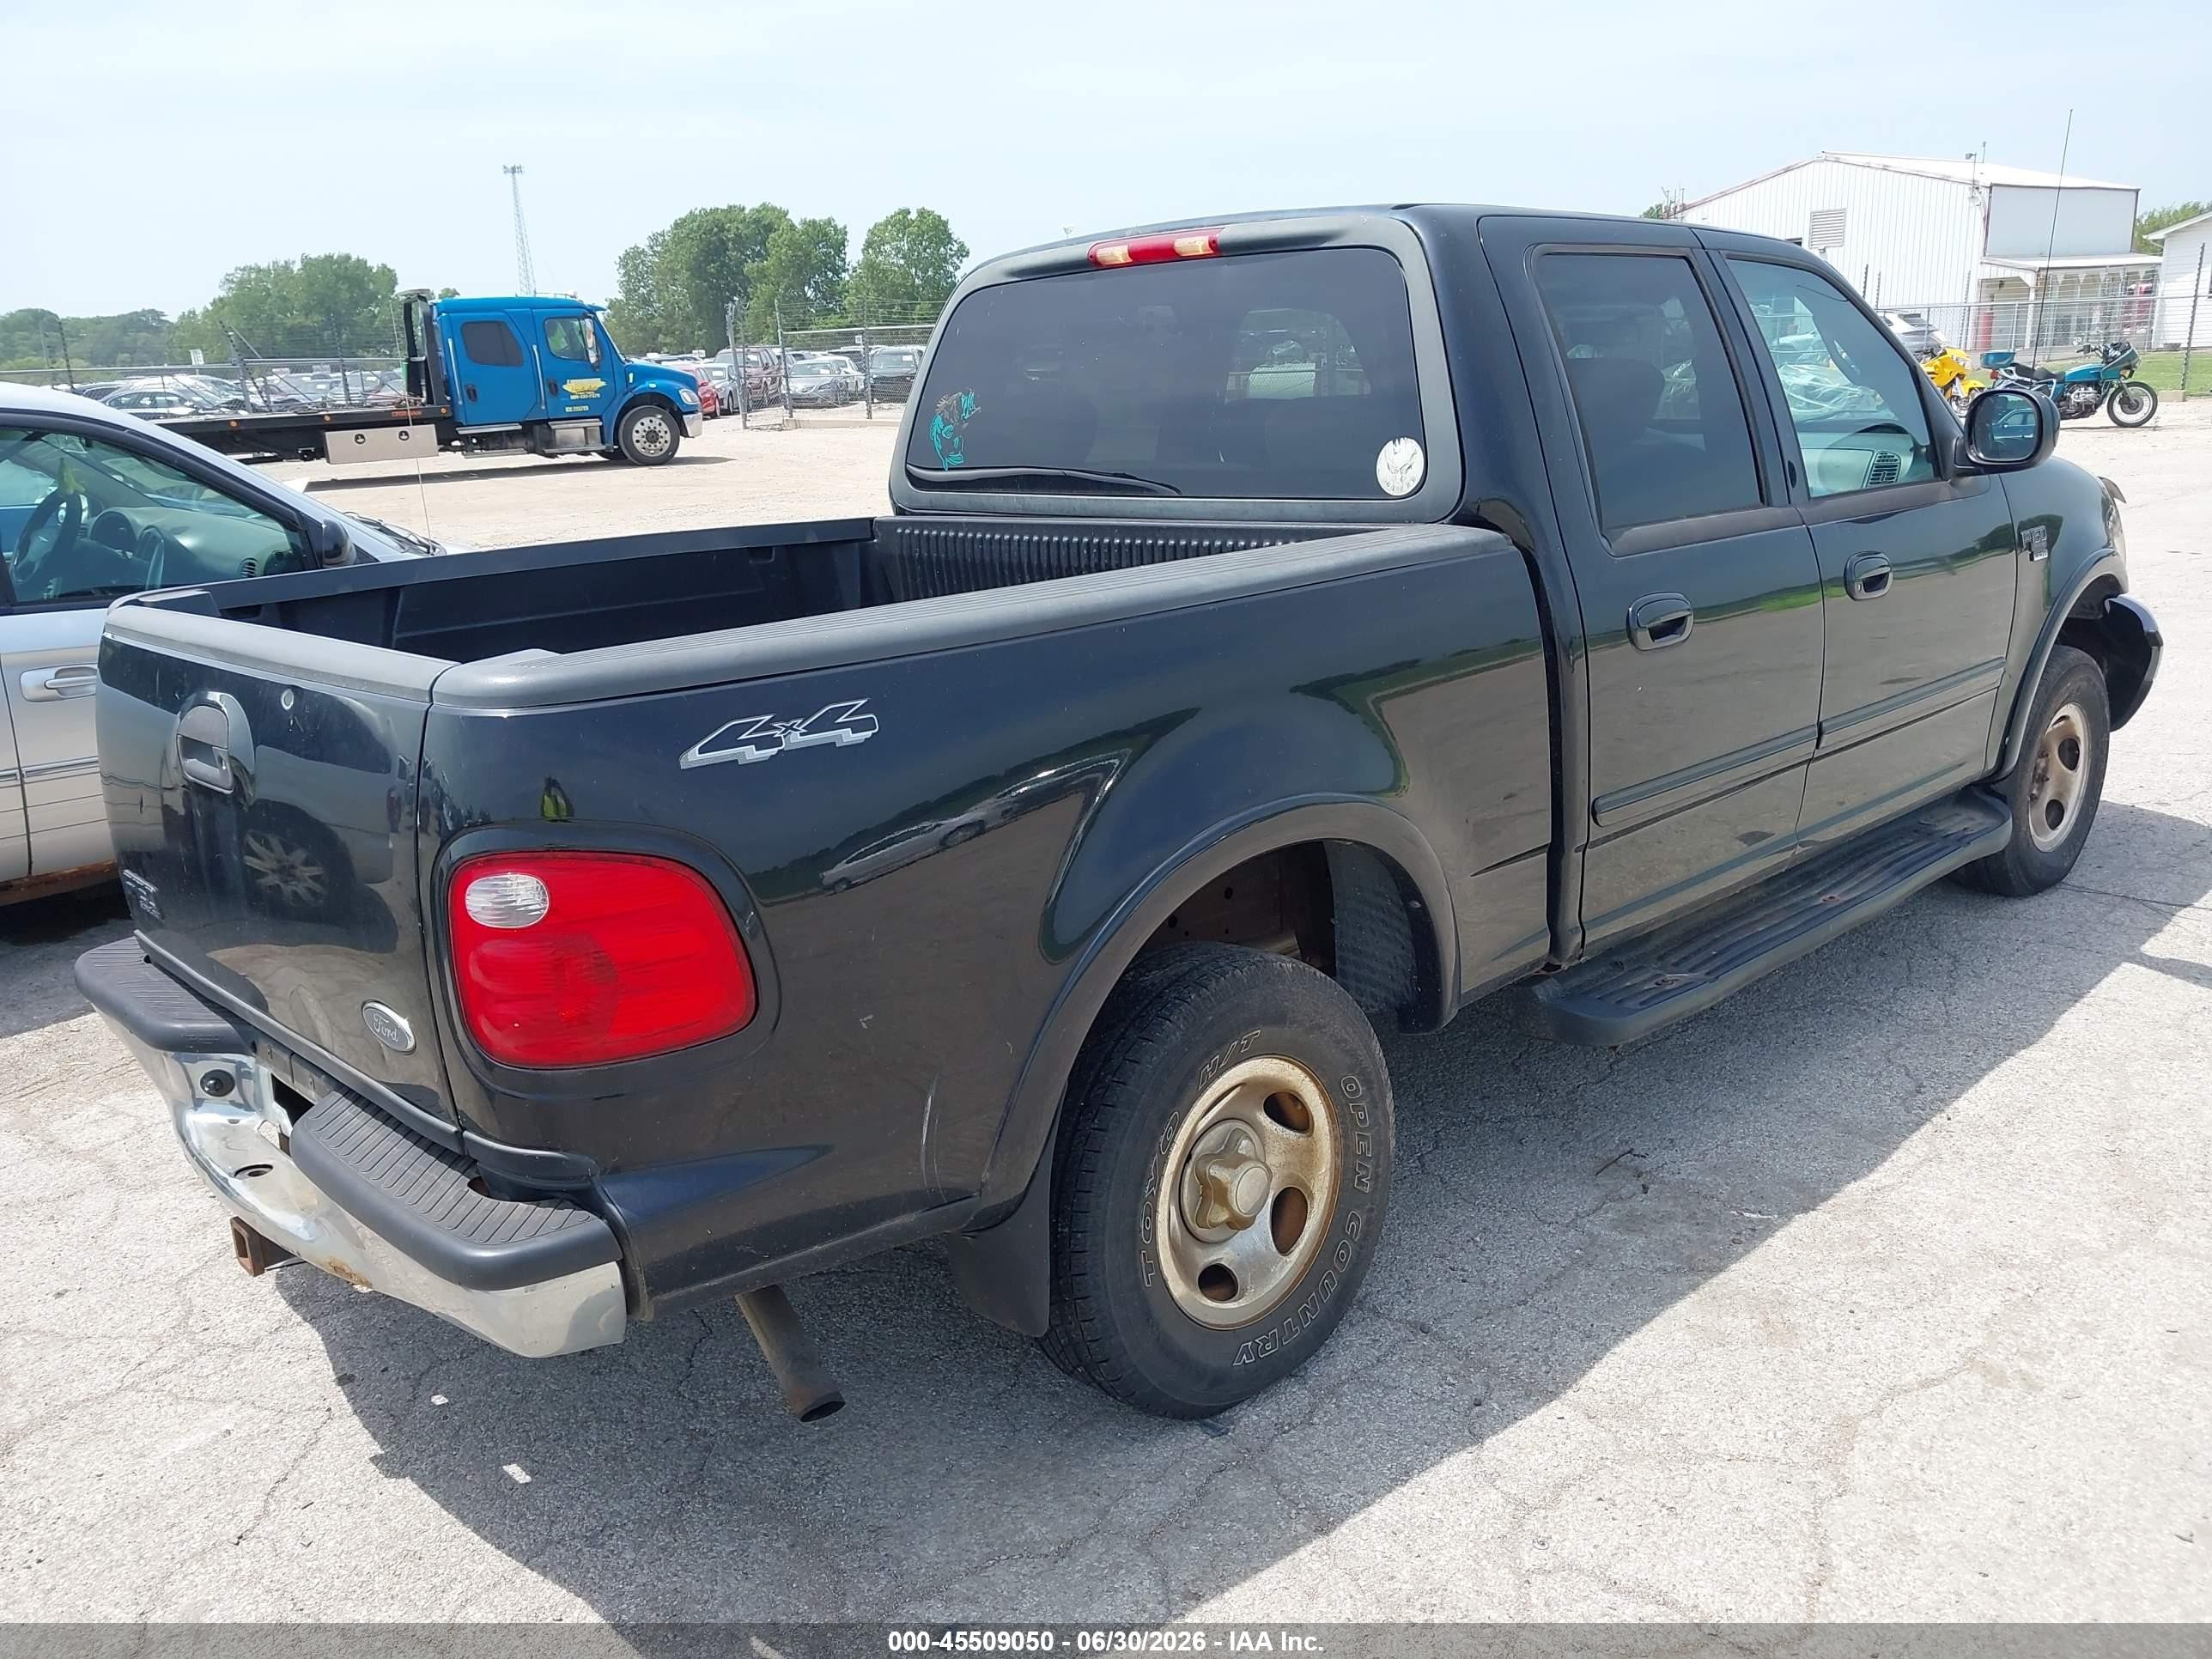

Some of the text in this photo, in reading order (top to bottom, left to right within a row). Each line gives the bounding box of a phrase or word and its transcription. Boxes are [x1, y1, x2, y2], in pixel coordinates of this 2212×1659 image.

[373, 1012, 399, 1042] Ford
[1140, 1030, 1261, 1287] TOYO H/T
[1232, 1075, 1372, 1367] OPEN COUNTRY
